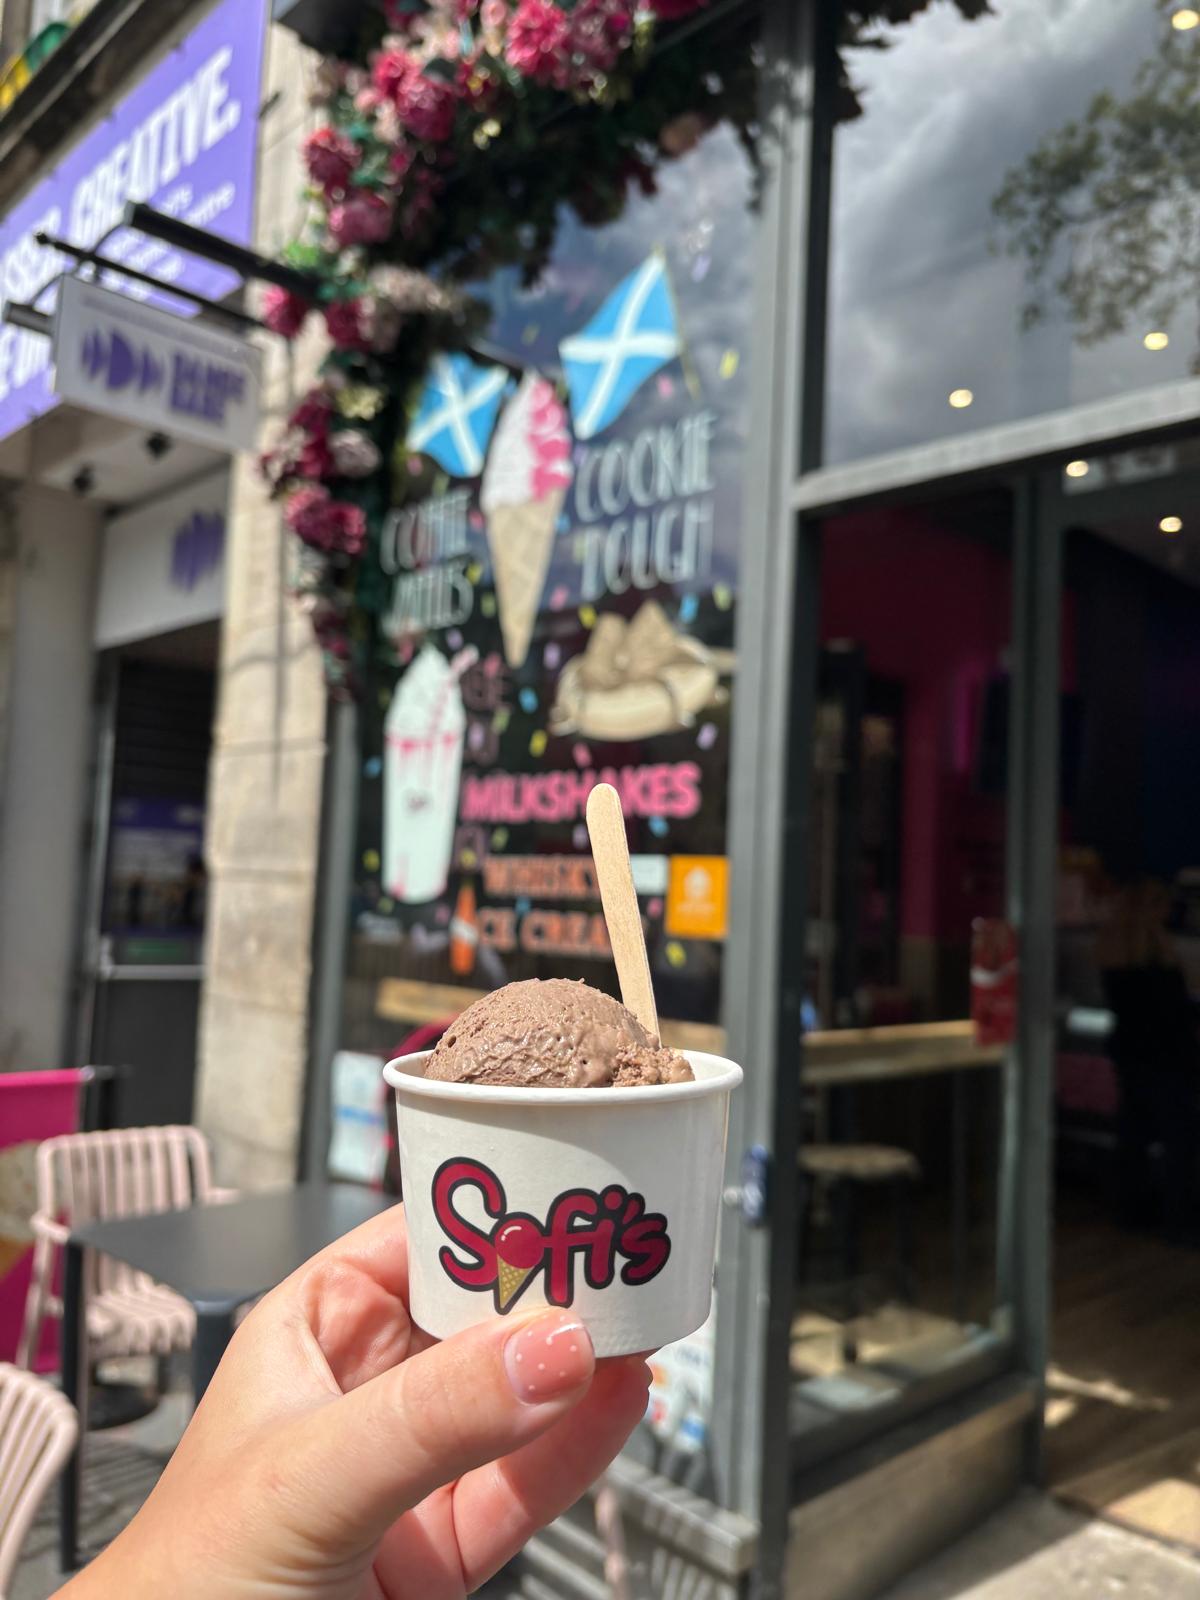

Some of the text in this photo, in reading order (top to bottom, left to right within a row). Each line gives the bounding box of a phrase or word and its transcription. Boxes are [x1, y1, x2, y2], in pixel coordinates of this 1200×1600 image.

[574, 411, 718, 521] COOKIE
[461, 761, 700, 823] MILKSHKES
[482, 854, 602, 897] WHISK
[519, 907, 616, 957] CREA
[431, 1157, 671, 1314] Sofi's
